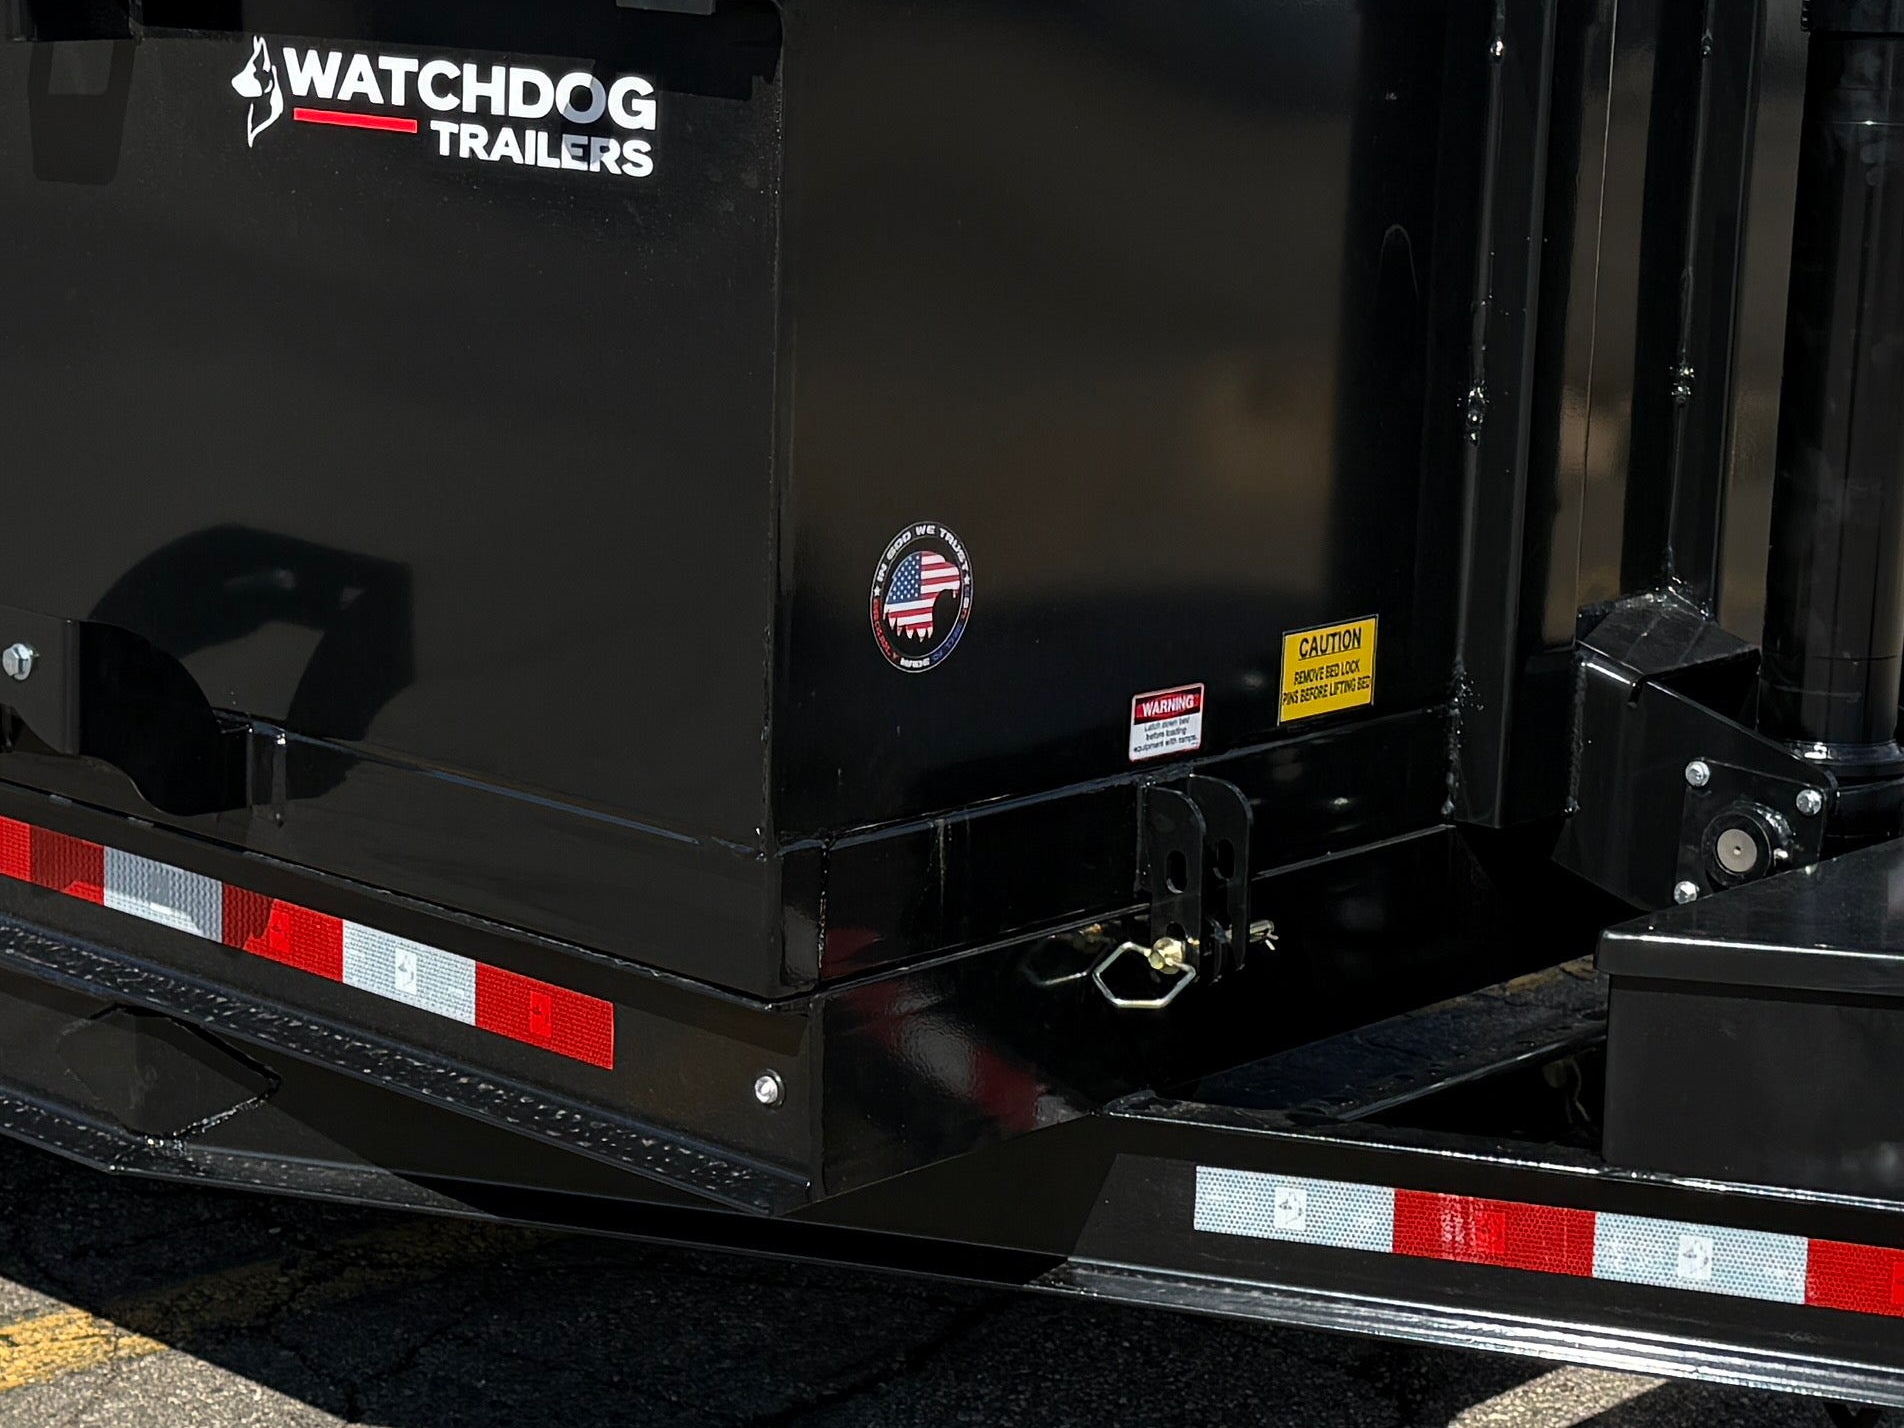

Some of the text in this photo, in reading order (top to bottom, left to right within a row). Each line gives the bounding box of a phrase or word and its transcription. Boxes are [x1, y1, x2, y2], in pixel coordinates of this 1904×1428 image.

[282, 46, 657, 131] WATCHDOG
[429, 119, 655, 178] TRAILERS
[876, 524, 969, 583] IN GOD WE TRUST
[1299, 626, 1362, 658] CAUTION
[1294, 658, 1360, 686] REMOVE BED LOCK
[1142, 693, 1195, 717] WARNING
[1282, 675, 1371, 705] PINS BEFORE LIFTING BED
